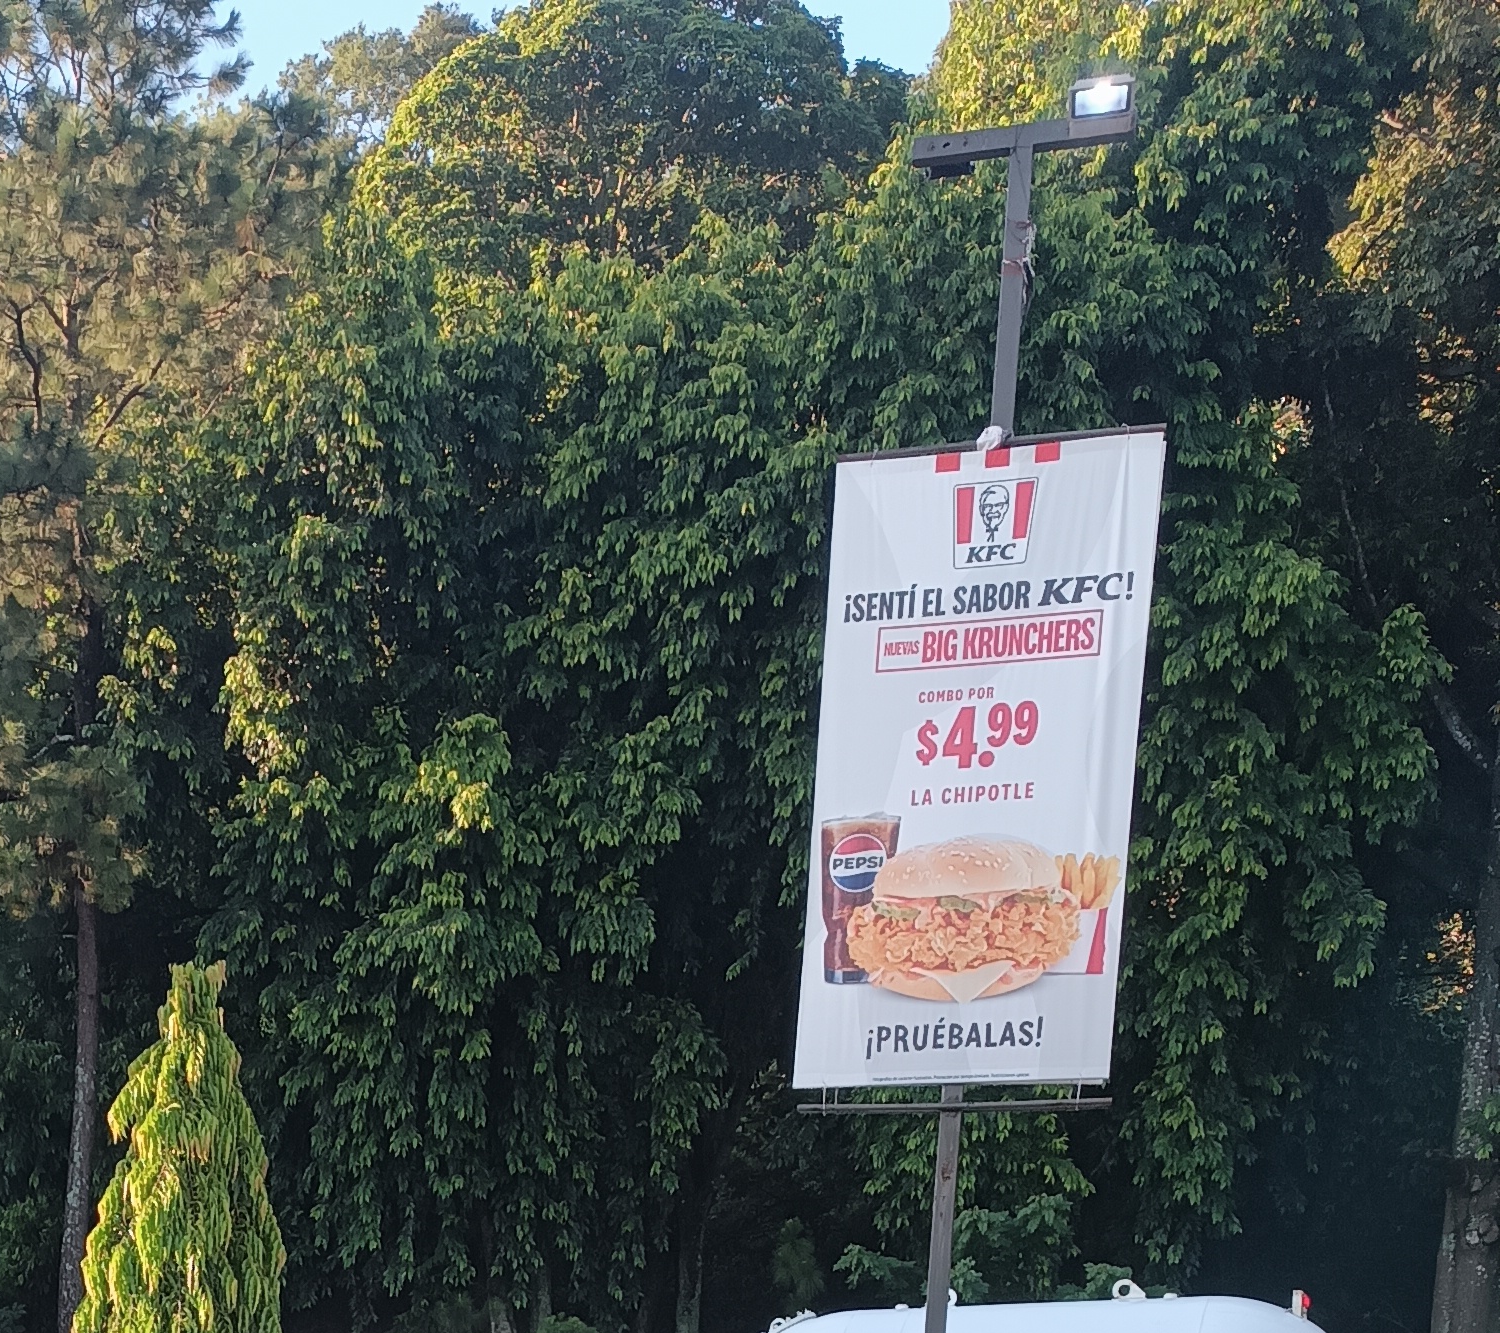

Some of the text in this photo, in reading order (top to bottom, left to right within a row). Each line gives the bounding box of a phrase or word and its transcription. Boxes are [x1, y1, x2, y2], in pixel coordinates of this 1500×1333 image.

[964, 542, 1017, 564] KFC
[843, 571, 1135, 623] ¡SENTÍ EL SABOR KFC!
[883, 617, 1095, 663] NUEVAS BIG KRUNCHERS
[918, 687, 994, 703] COMBO POR
[915, 700, 1039, 769] $4.99
[910, 782, 1034, 806] LA CHIPOTLE
[832, 856, 884, 870] PEPSI
[865, 1016, 1044, 1060] ¡PRUÉBALAS!
